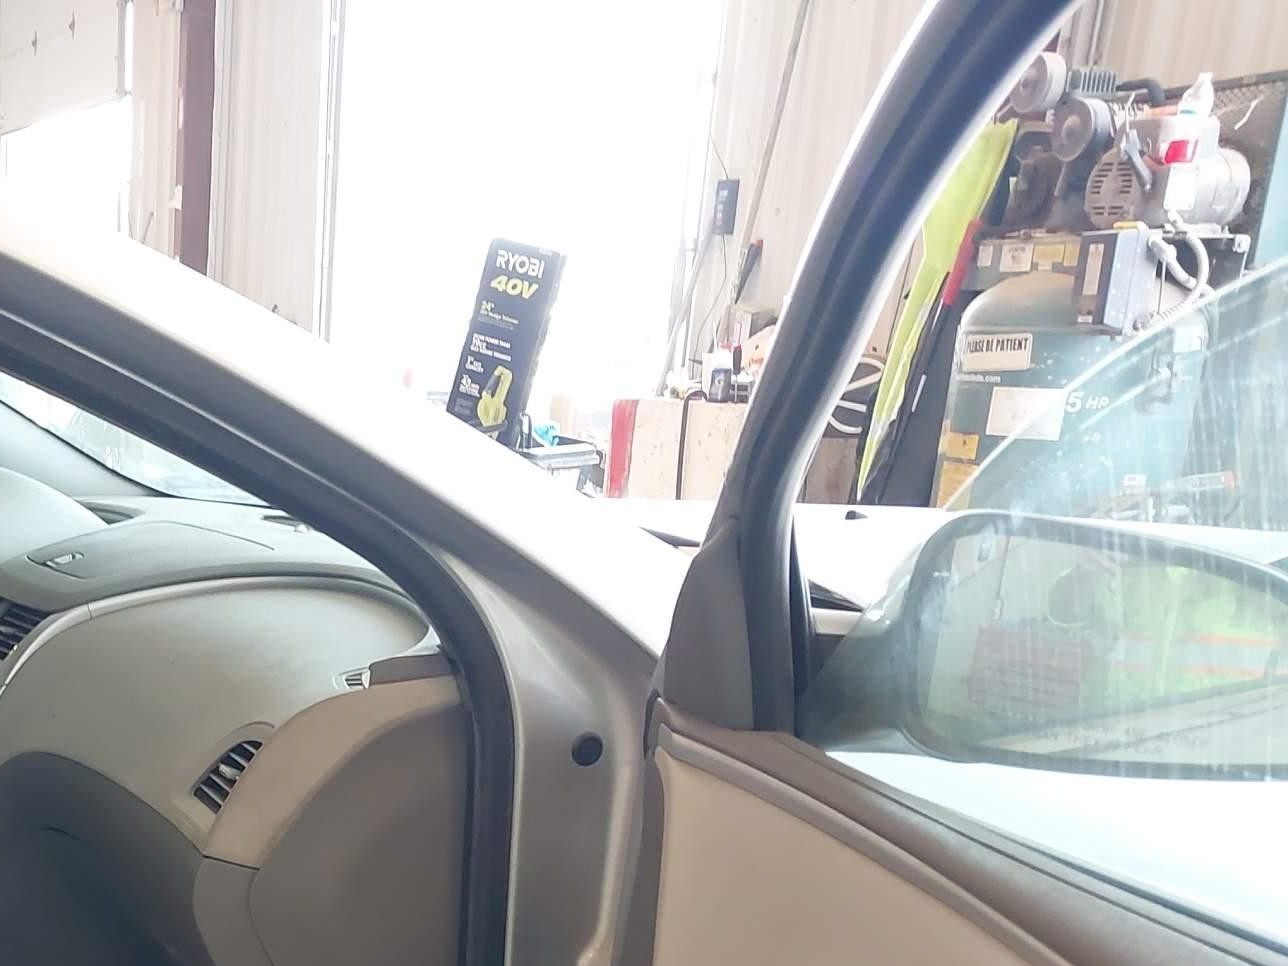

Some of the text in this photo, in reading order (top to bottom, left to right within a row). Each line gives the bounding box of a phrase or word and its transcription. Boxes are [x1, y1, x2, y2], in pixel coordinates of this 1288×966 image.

[496, 249, 545, 279] RYOBI
[490, 275, 539, 299] 40V
[967, 339, 984, 354] PLEASE
[995, 337, 1029, 352] PATIENT
[1066, 391, 1110, 413] 5 HP
